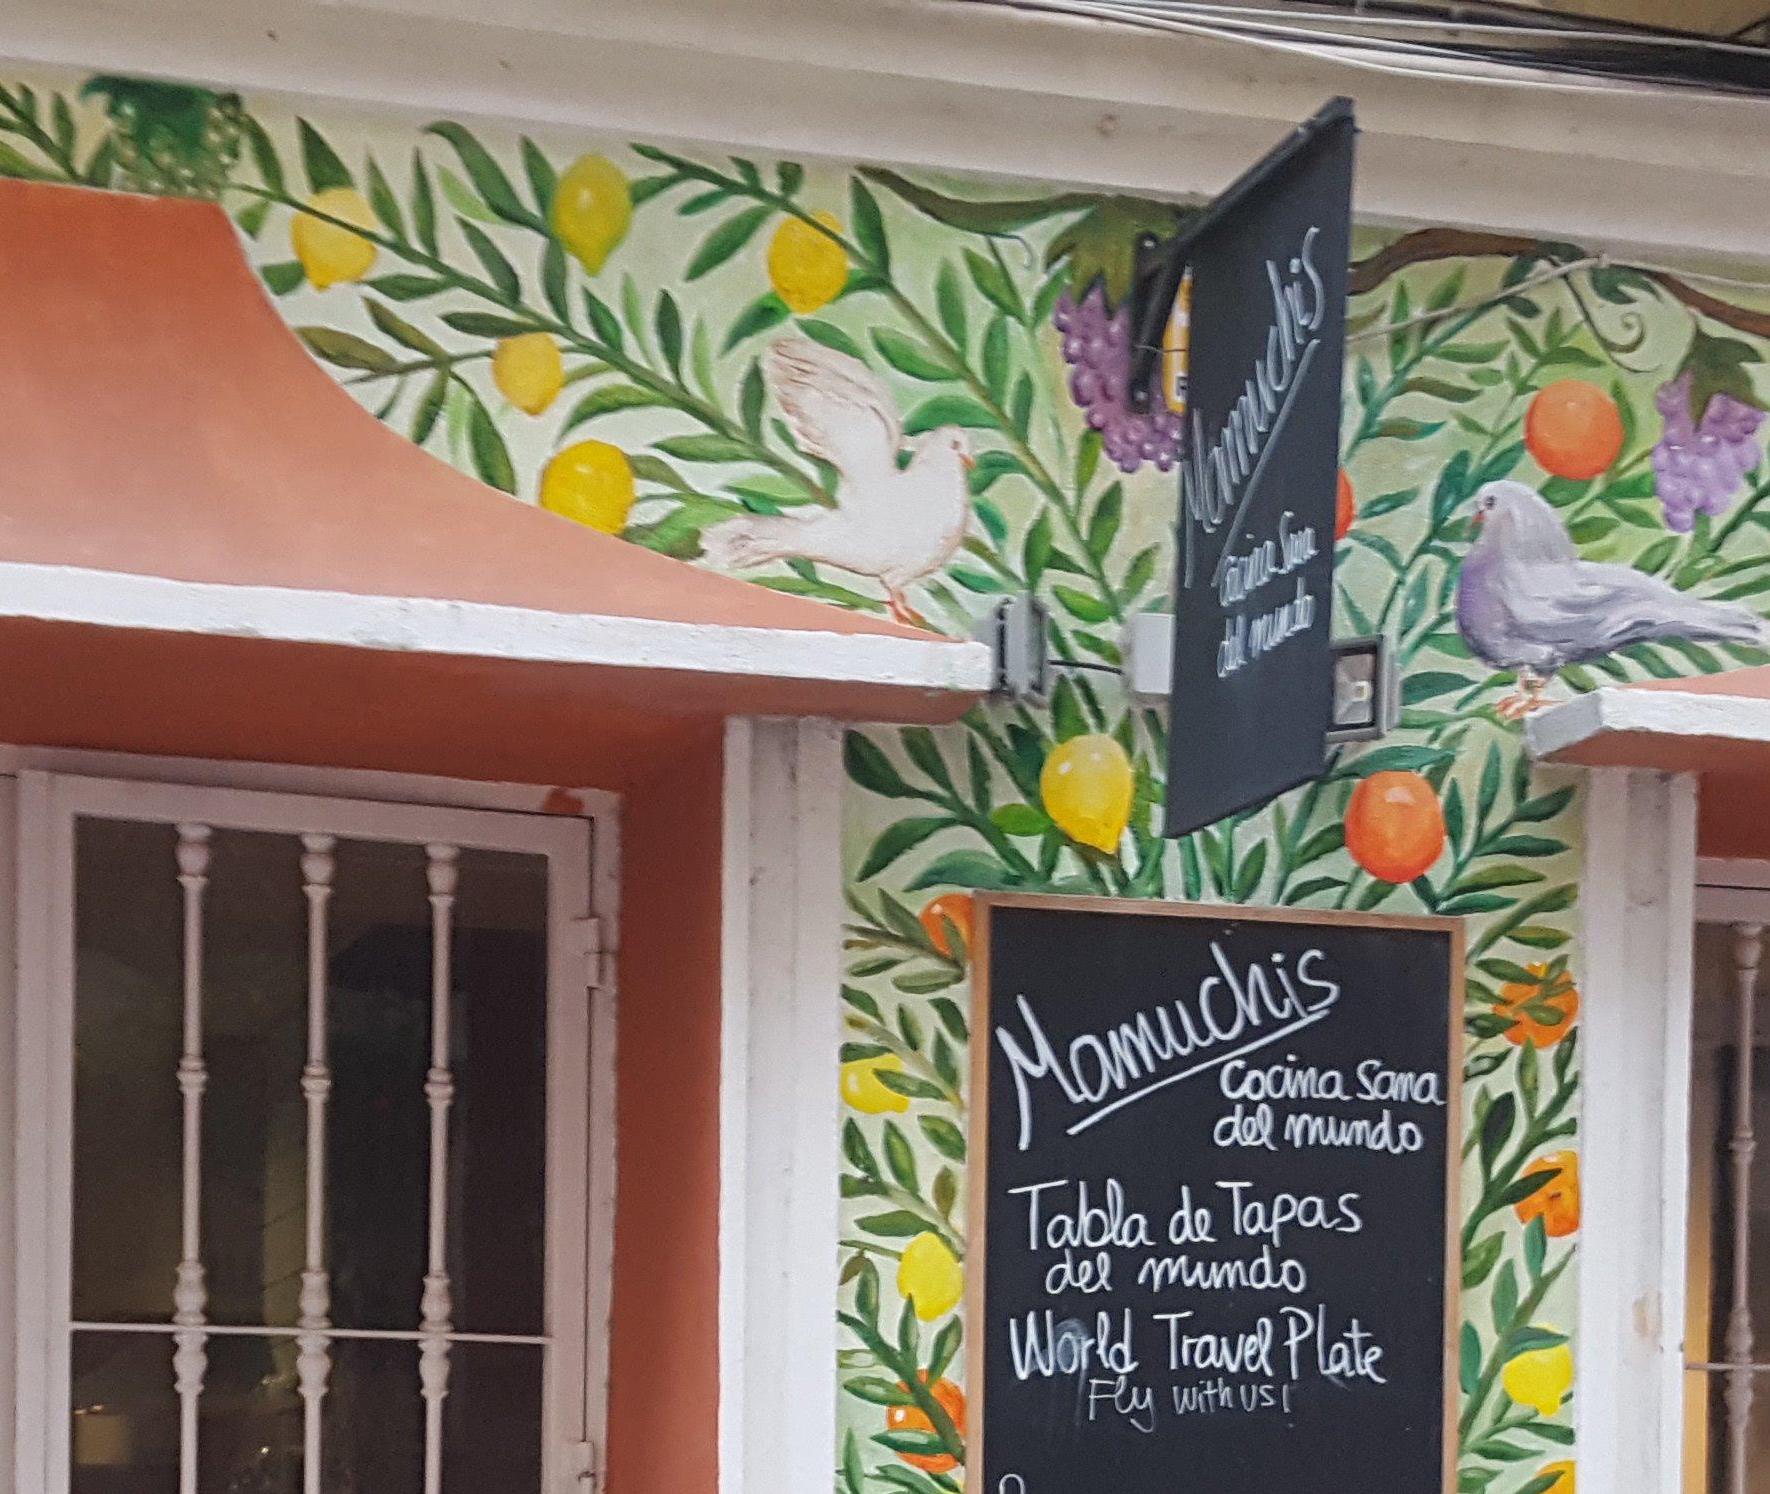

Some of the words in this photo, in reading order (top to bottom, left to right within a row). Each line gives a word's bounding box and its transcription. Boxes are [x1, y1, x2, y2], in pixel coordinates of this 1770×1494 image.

[1183, 226, 1326, 588] Mamuchis
[995, 941, 1341, 1152] Mamuchis
[1218, 1053, 1351, 1102] Cocina
[1213, 1103, 1279, 1152] del
[1283, 1108, 1424, 1154] mundo
[1008, 1177, 1156, 1251] Tabla
[1168, 1185, 1218, 1243] de
[1214, 1180, 1363, 1248] Tapas
[1044, 1250, 1113, 1295] del
[1137, 1243, 1308, 1295] mundo
[1009, 1308, 1140, 1380] World
[1152, 1310, 1273, 1376] Travel
[1278, 1303, 1388, 1384] Plate
[1088, 1378, 1156, 1433] Fly
[1172, 1378, 1235, 1414] with
